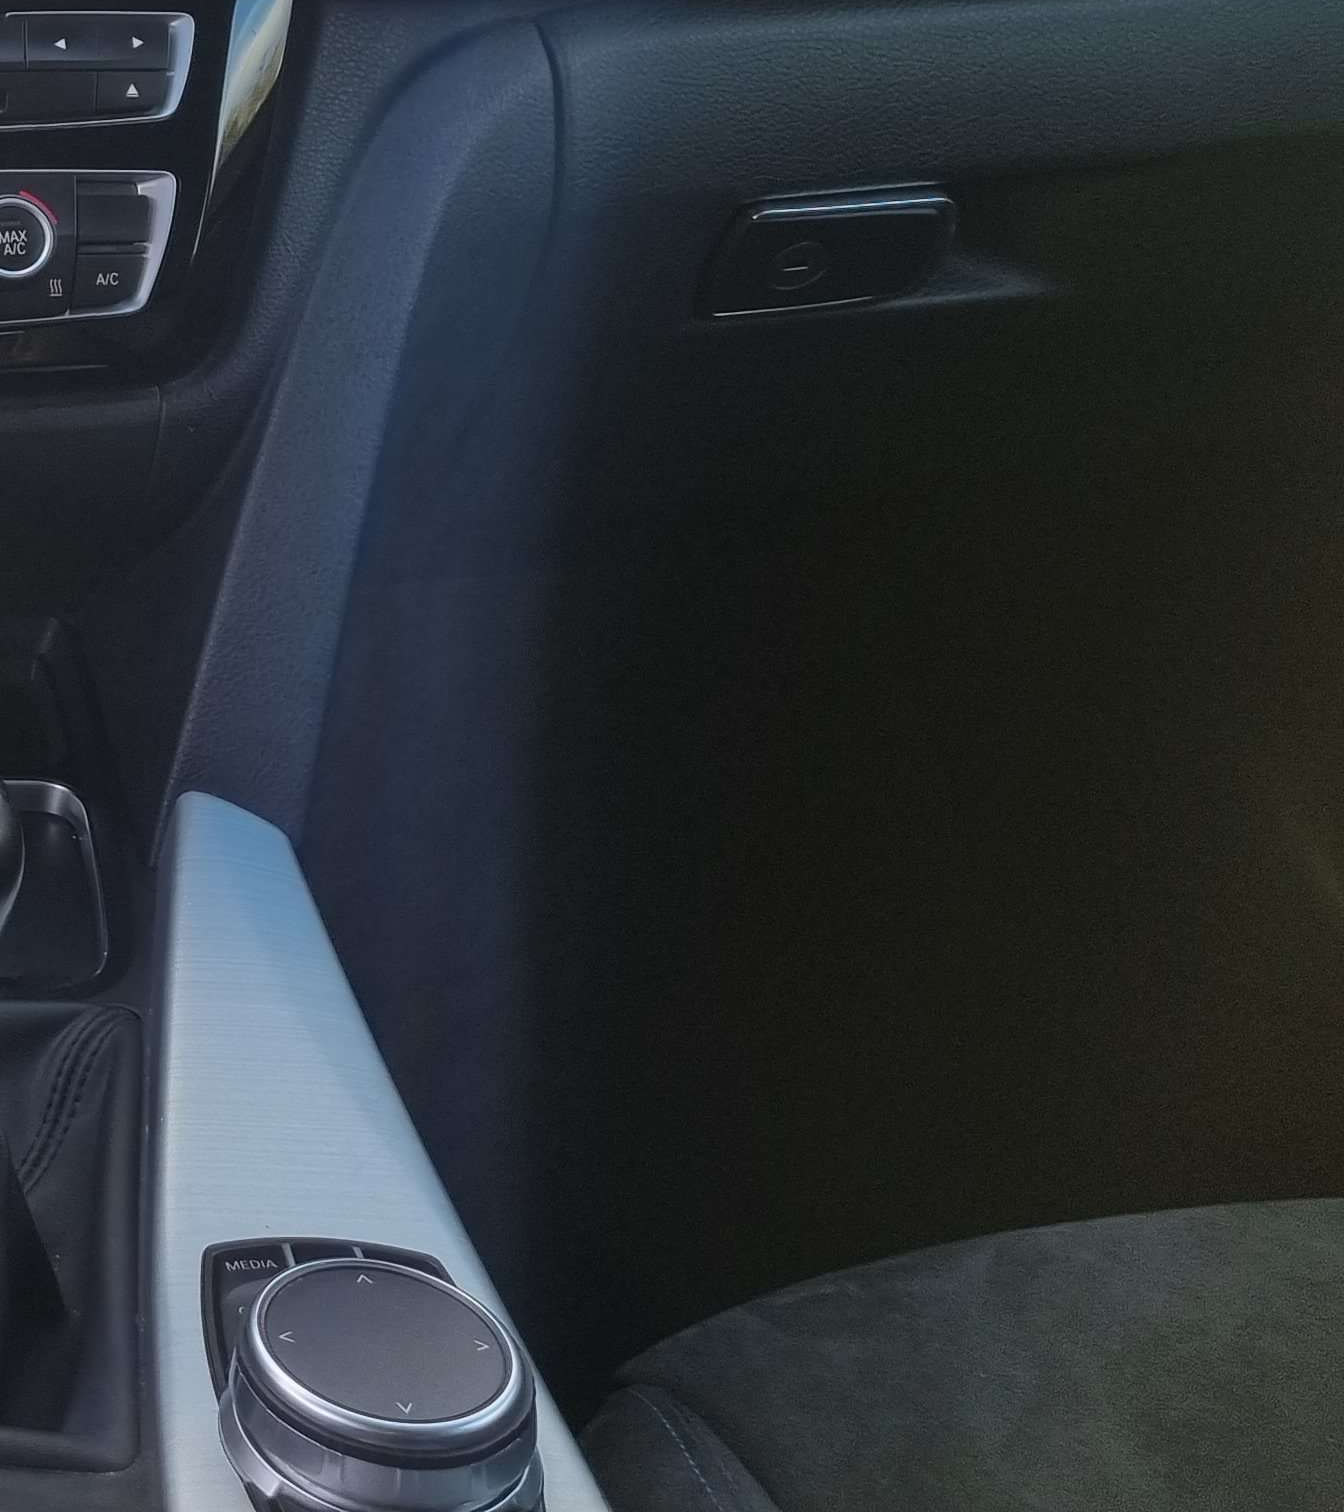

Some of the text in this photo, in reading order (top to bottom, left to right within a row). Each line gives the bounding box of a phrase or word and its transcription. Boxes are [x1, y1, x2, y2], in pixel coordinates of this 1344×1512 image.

[3, 243, 26, 256] A/C
[96, 273, 119, 286] A/C
[225, 1258, 278, 1272] MEDIA
